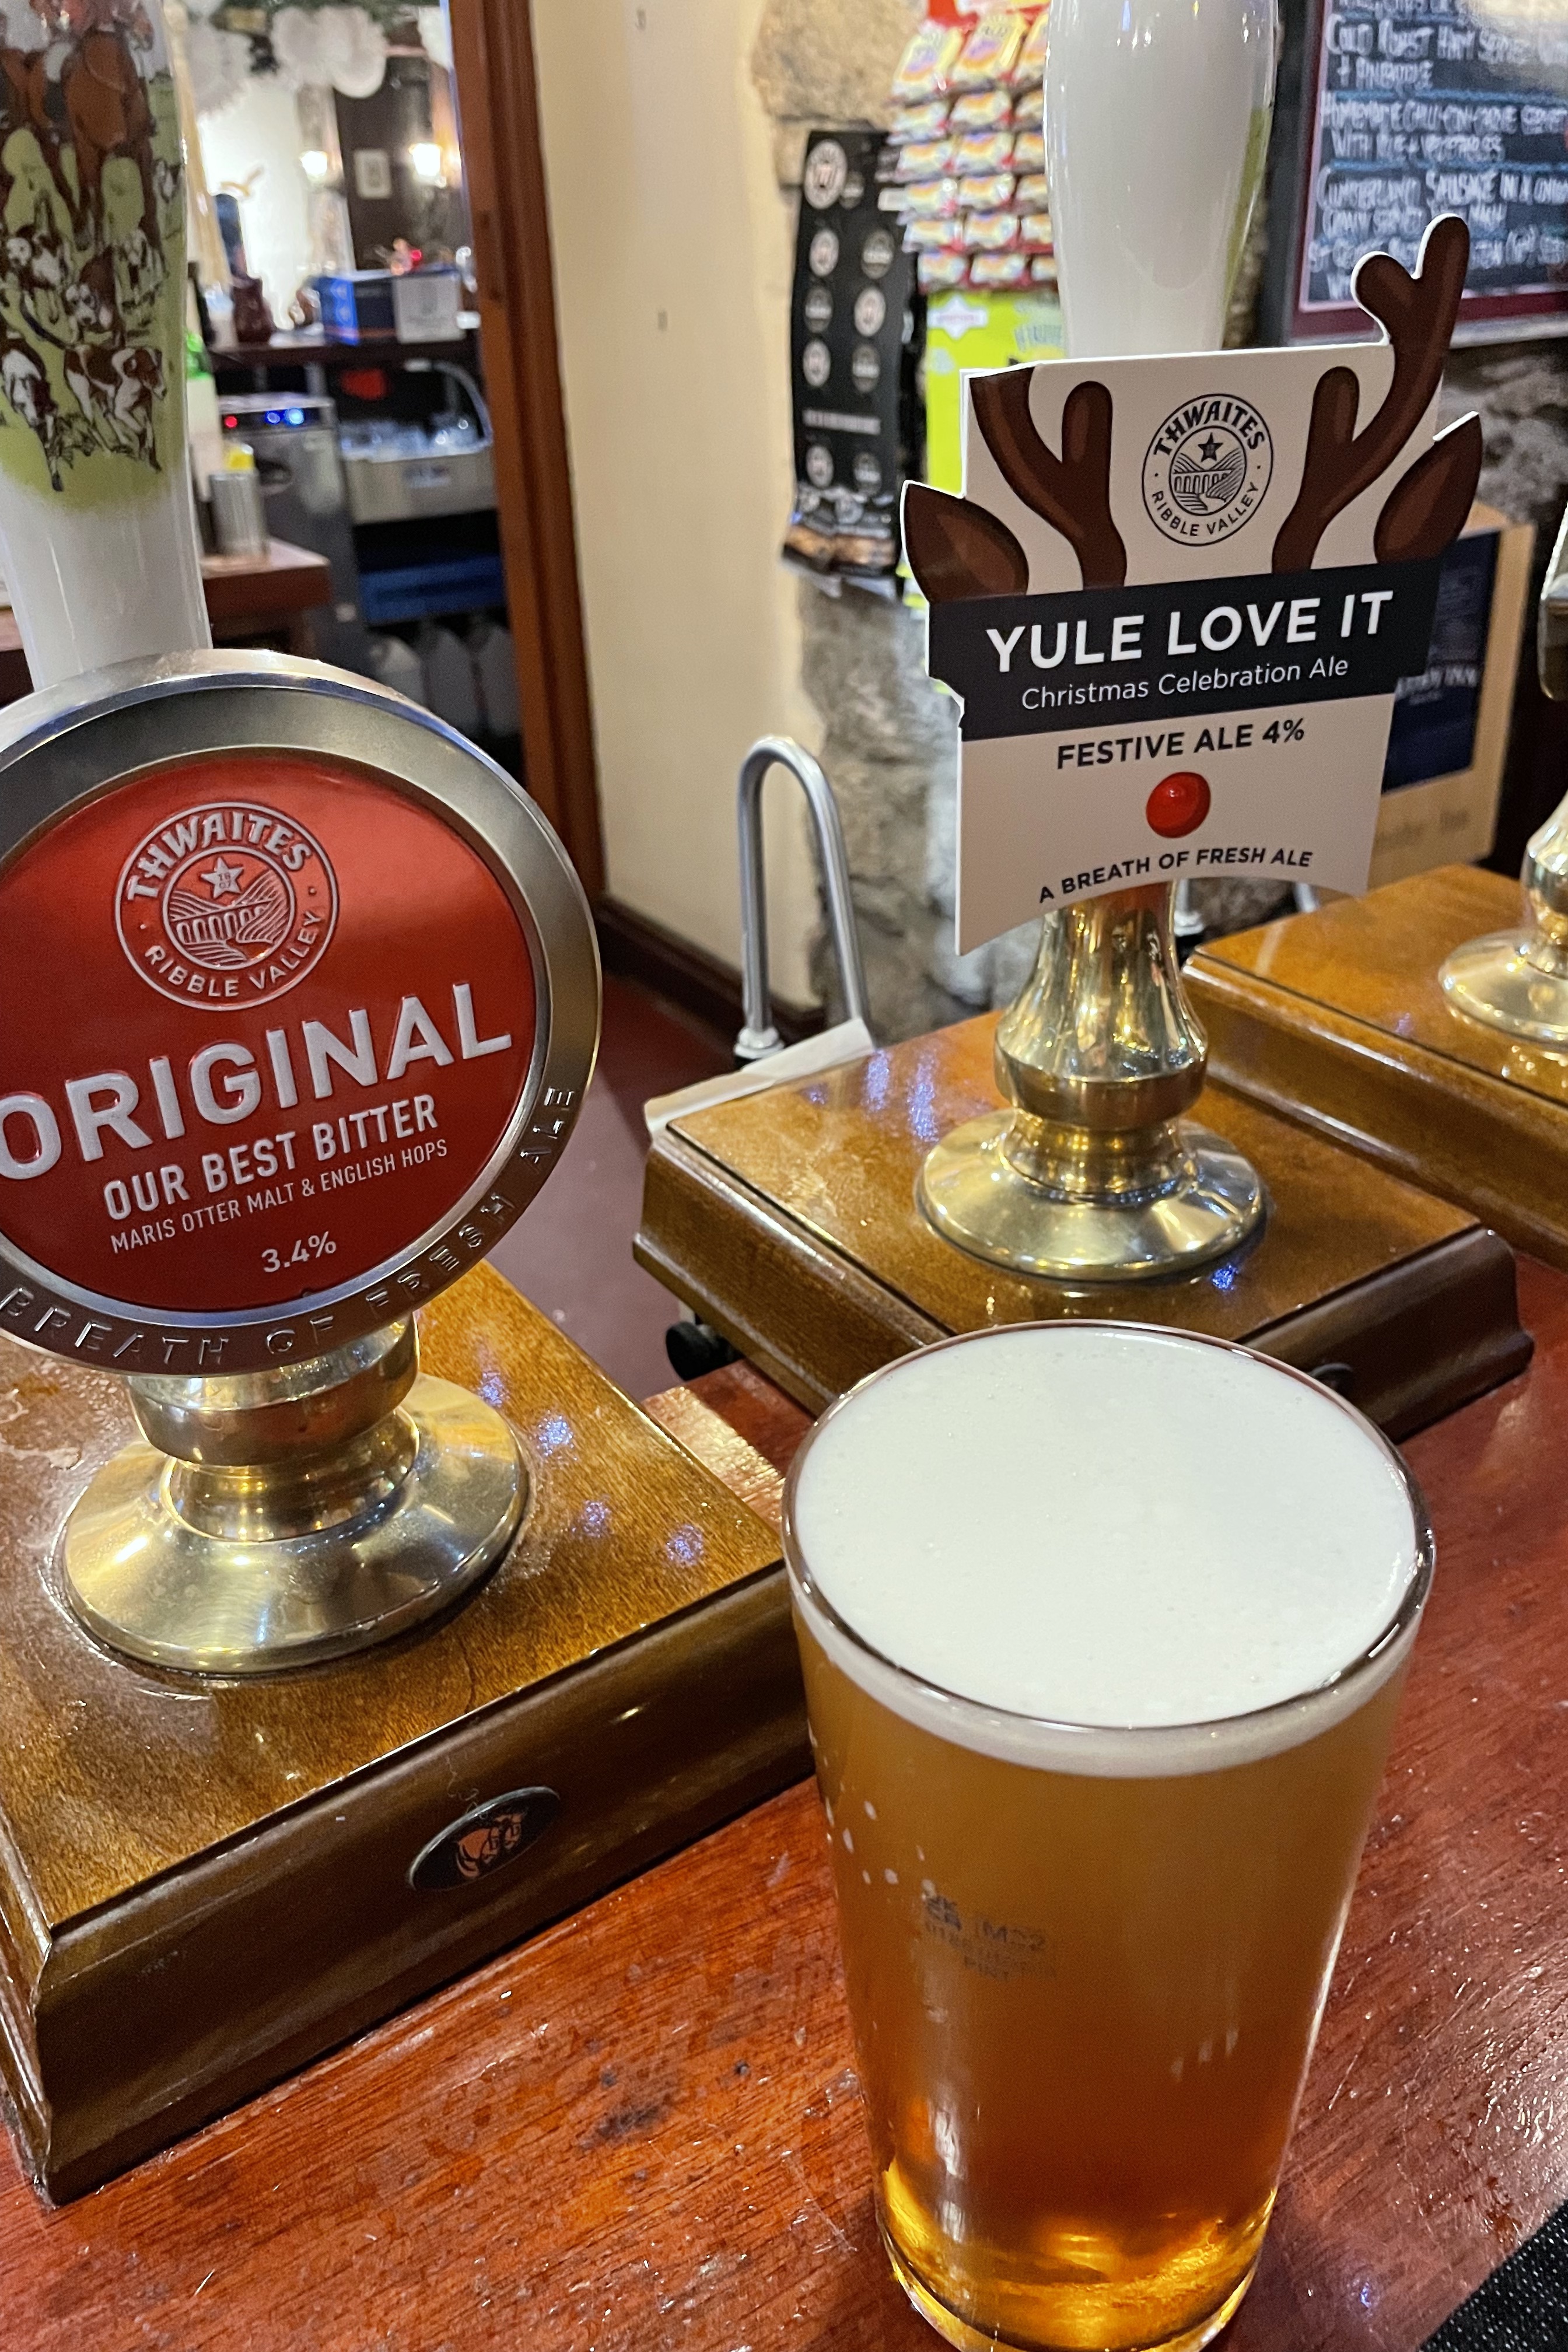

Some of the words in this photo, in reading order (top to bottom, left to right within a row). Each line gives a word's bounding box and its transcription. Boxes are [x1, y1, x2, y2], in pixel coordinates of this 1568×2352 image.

[1153, 400, 1265, 456] THWAITES
[1152, 491, 1199, 536] RIBBLE
[1206, 481, 1259, 535] VALLEY
[986, 614, 1144, 673] YULE
[1168, 597, 1321, 656] LOVE
[1341, 590, 1394, 638] IT
[1022, 681, 1149, 709] Christmas
[1158, 663, 1301, 695] Celebration
[1308, 656, 1349, 678] Ale
[1057, 732, 1185, 769] FESTIVE
[1194, 724, 1254, 754] ALE
[1262, 718, 1305, 744] 4%
[127, 811, 312, 901] THWAITES
[1039, 886, 1055, 904] A
[1060, 857, 1150, 894] BREATH
[1158, 851, 1190, 870] OF
[1196, 848, 1266, 865] FRESH
[1270, 848, 1312, 868] ALE
[145, 945, 239, 998] RIBBLE
[249, 911, 321, 990] VALLEY
[0, 983, 513, 1180] ORIGINAL
[104, 1165, 190, 1220] OUR
[202, 1132, 296, 1193] BEST
[313, 1094, 438, 1161] BITTER
[111, 1219, 176, 1254] MARIS
[182, 1199, 241, 1232] OTTER
[247, 1183, 294, 1214] MALT
[302, 1178, 315, 1196] &
[320, 1154, 396, 1192] ENGLISH
[401, 1139, 447, 1167] HOPS
[261, 1231, 337, 1273] 3.4%
[266, 1314, 334, 1355] OF
